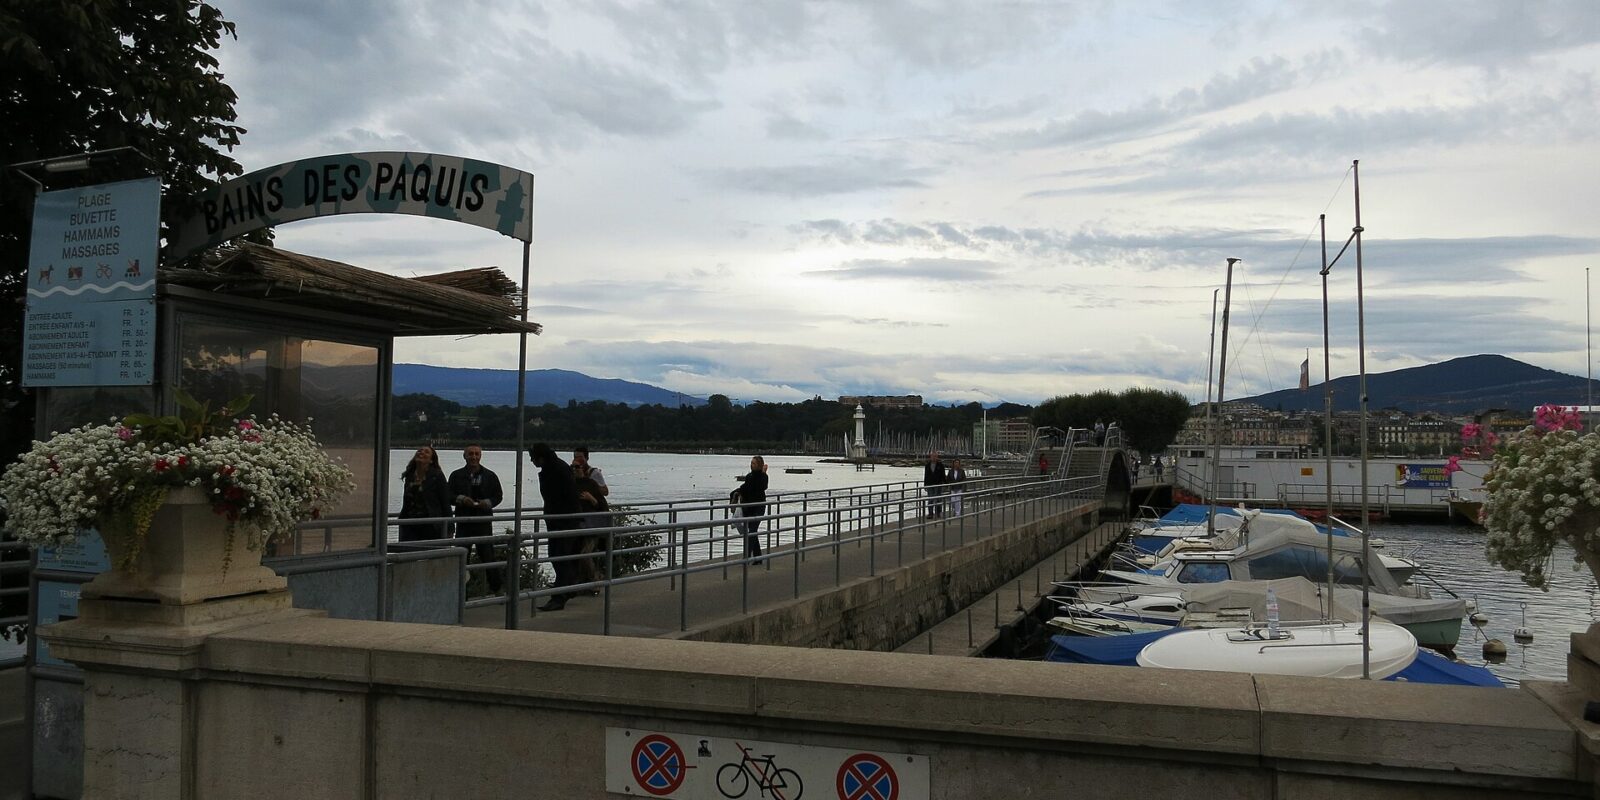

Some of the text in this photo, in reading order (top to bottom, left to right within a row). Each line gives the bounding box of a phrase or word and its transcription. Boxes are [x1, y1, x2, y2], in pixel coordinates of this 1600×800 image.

[78, 193, 111, 209] PLAGE
[203, 163, 488, 235] BAINS DES PAQUIS
[70, 209, 116, 225] BUVETTE
[64, 226, 120, 243] HAMMAMS
[62, 243, 119, 259] MASSAGES
